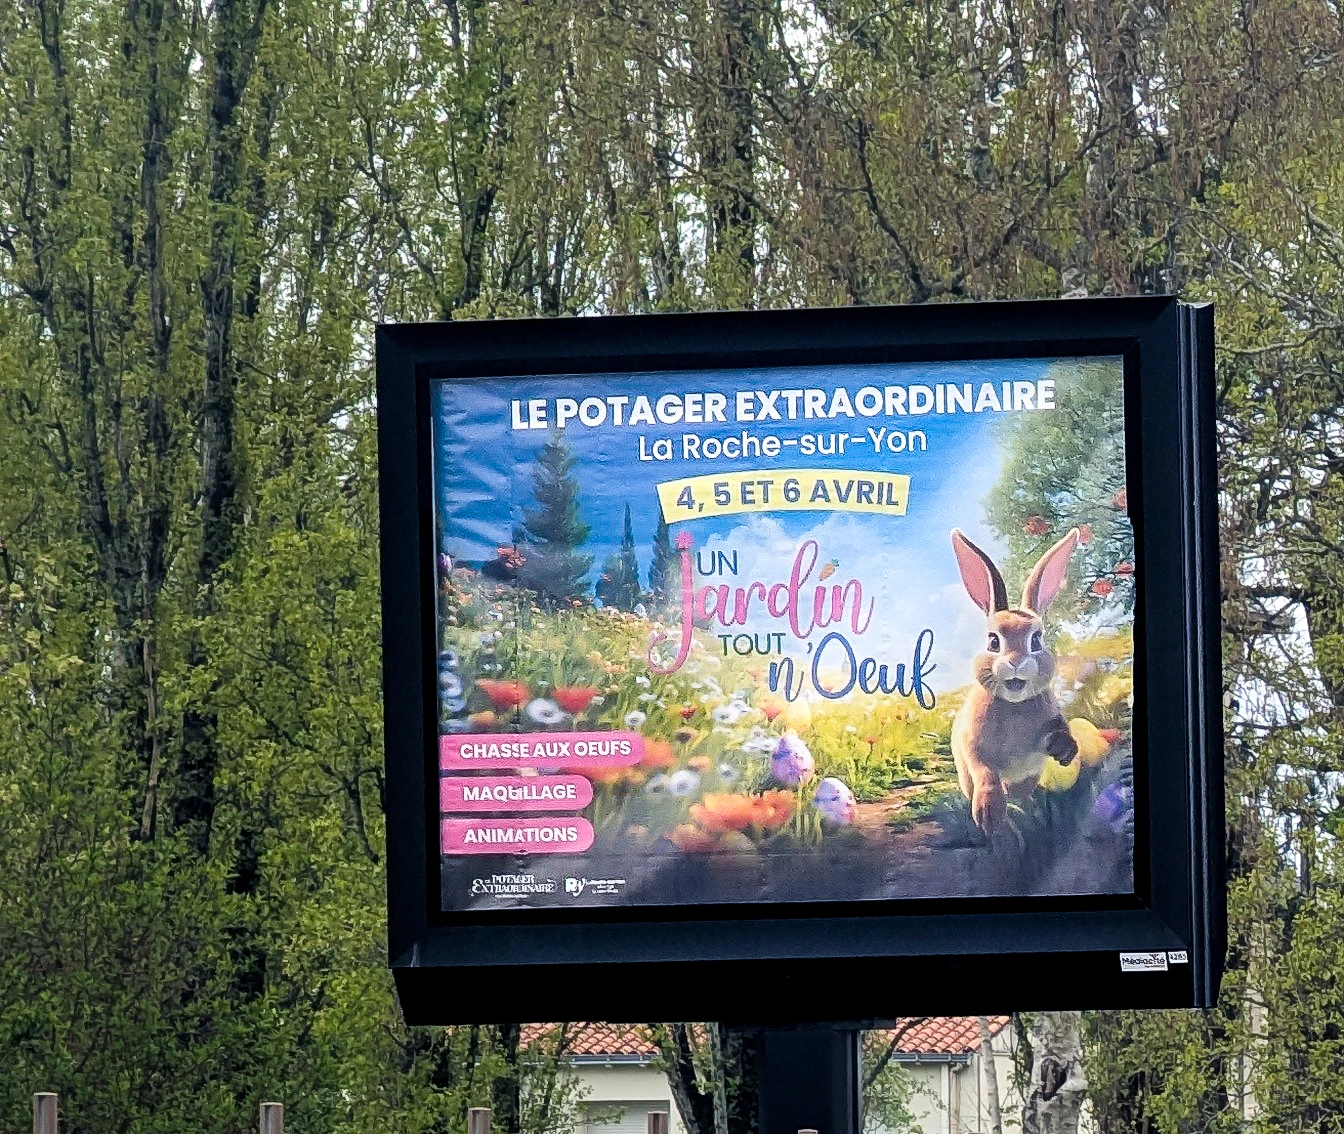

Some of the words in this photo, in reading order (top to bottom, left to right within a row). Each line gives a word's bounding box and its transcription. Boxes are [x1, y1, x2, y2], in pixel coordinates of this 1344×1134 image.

[511, 399, 548, 430] LE
[556, 393, 727, 428] POTAGER
[736, 380, 1056, 422] EXTRAORDINAIRE
[638, 435, 673, 461] La
[682, 427, 928, 460] Roche-sur-Yon
[676, 485, 705, 512] 4,
[713, 481, 731, 506] 5
[740, 479, 774, 505] ET
[783, 478, 801, 503] 6
[809, 478, 899, 506] AVRIL
[696, 549, 738, 576] UN
[717, 632, 787, 657] TOUT
[769, 628, 937, 710] n'Oeuf
[460, 743, 529, 758] CHASSE
[533, 742, 570, 757] AUX
[574, 740, 631, 756] OEUFS
[463, 784, 577, 802] MAQUILLAGE
[463, 826, 578, 844] ANIMATIONS
